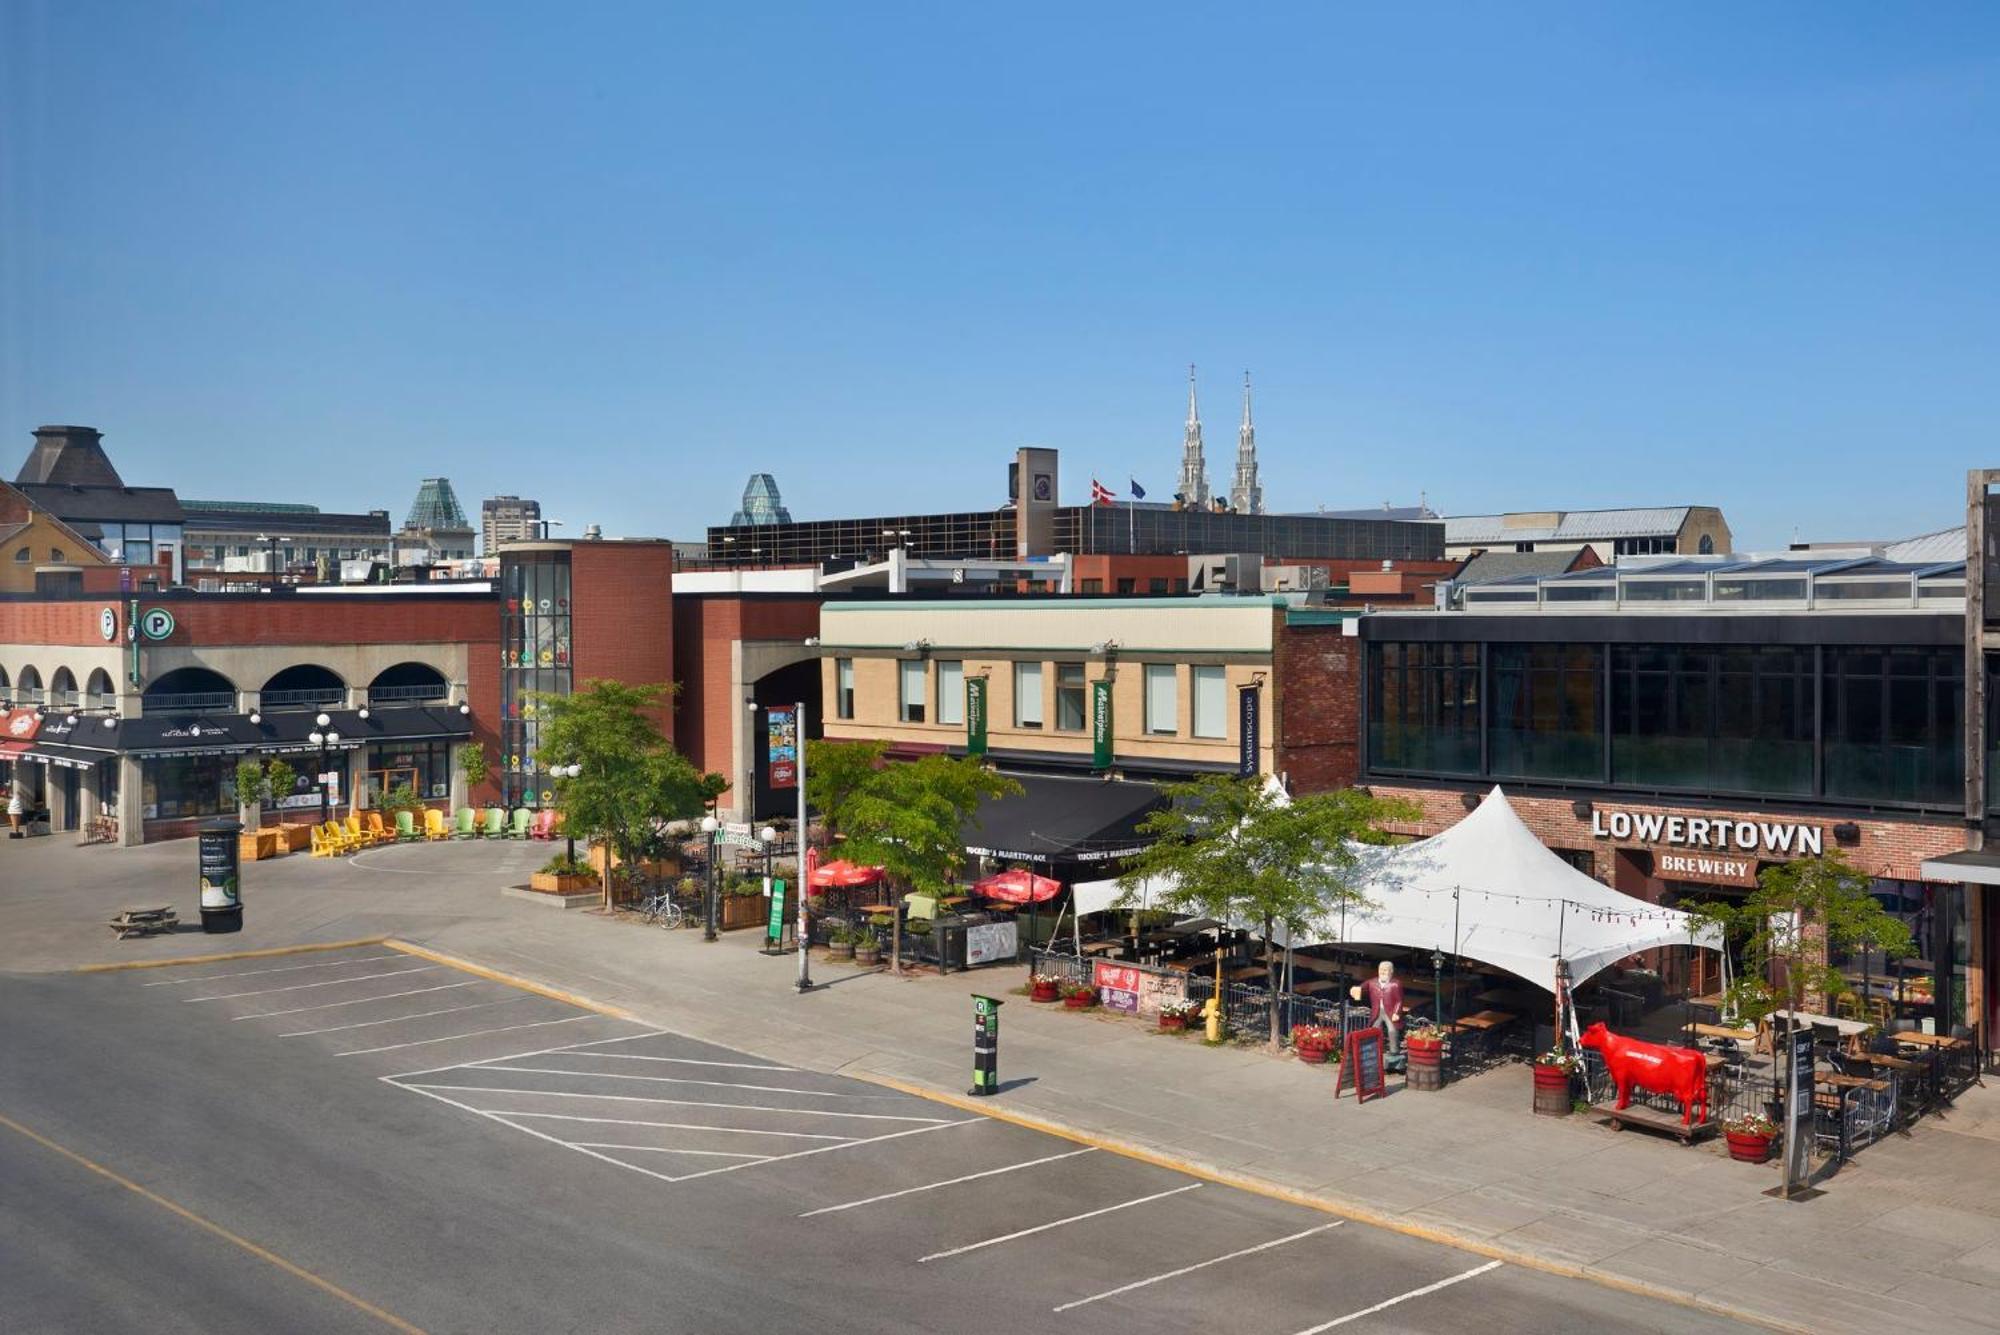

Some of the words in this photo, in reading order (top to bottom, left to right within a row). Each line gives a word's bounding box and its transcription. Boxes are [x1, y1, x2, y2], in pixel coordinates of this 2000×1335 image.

[152, 617, 165, 632] P
[1246, 696, 1254, 773] Systemscope
[1592, 810, 1822, 855] LOWERTOWN
[1661, 855, 1748, 877] BREWERY
